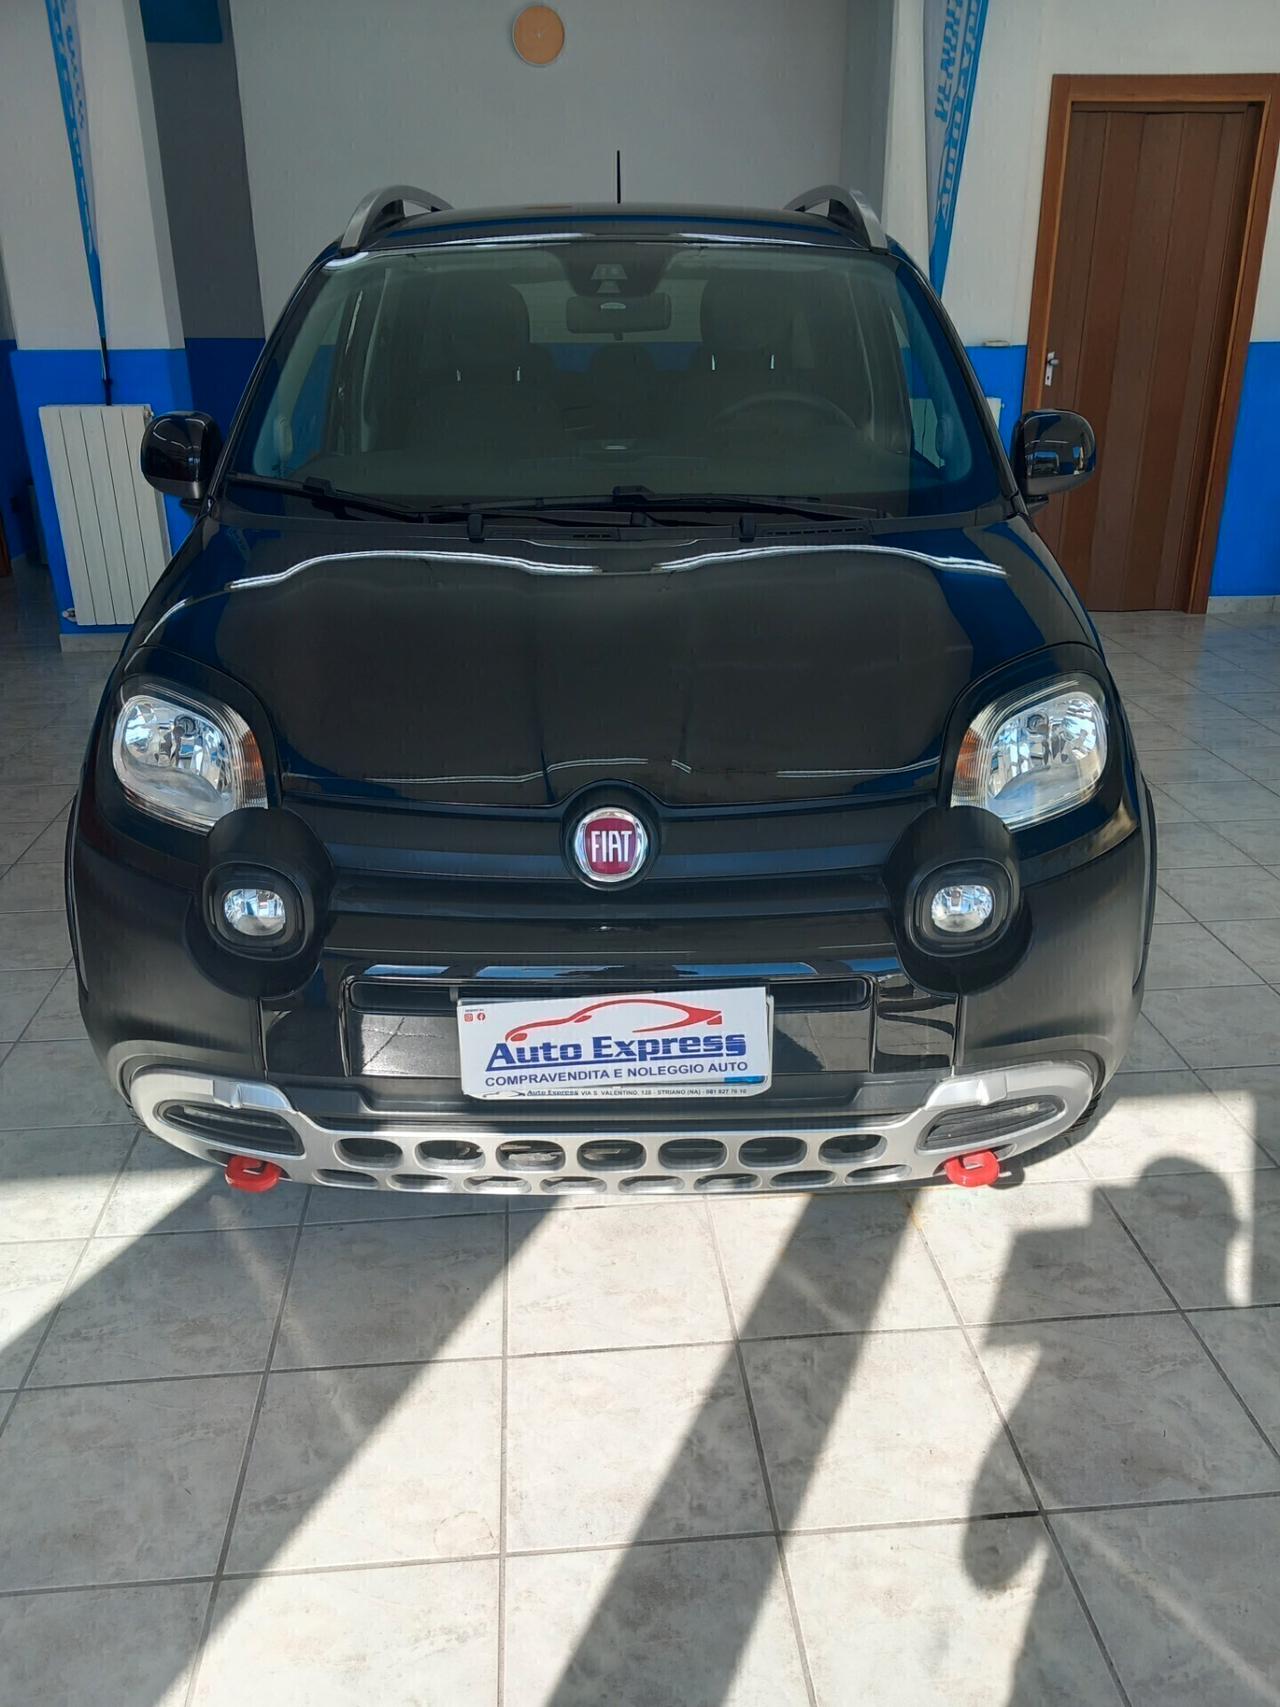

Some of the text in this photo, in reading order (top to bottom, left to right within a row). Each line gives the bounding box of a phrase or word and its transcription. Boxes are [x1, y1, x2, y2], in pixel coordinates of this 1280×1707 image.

[591, 830, 632, 863] FIAT
[485, 1034, 747, 1071] Auto Express
[485, 1062, 748, 1087] COMPRAVENDITA E NOLEGGIO AUTO
